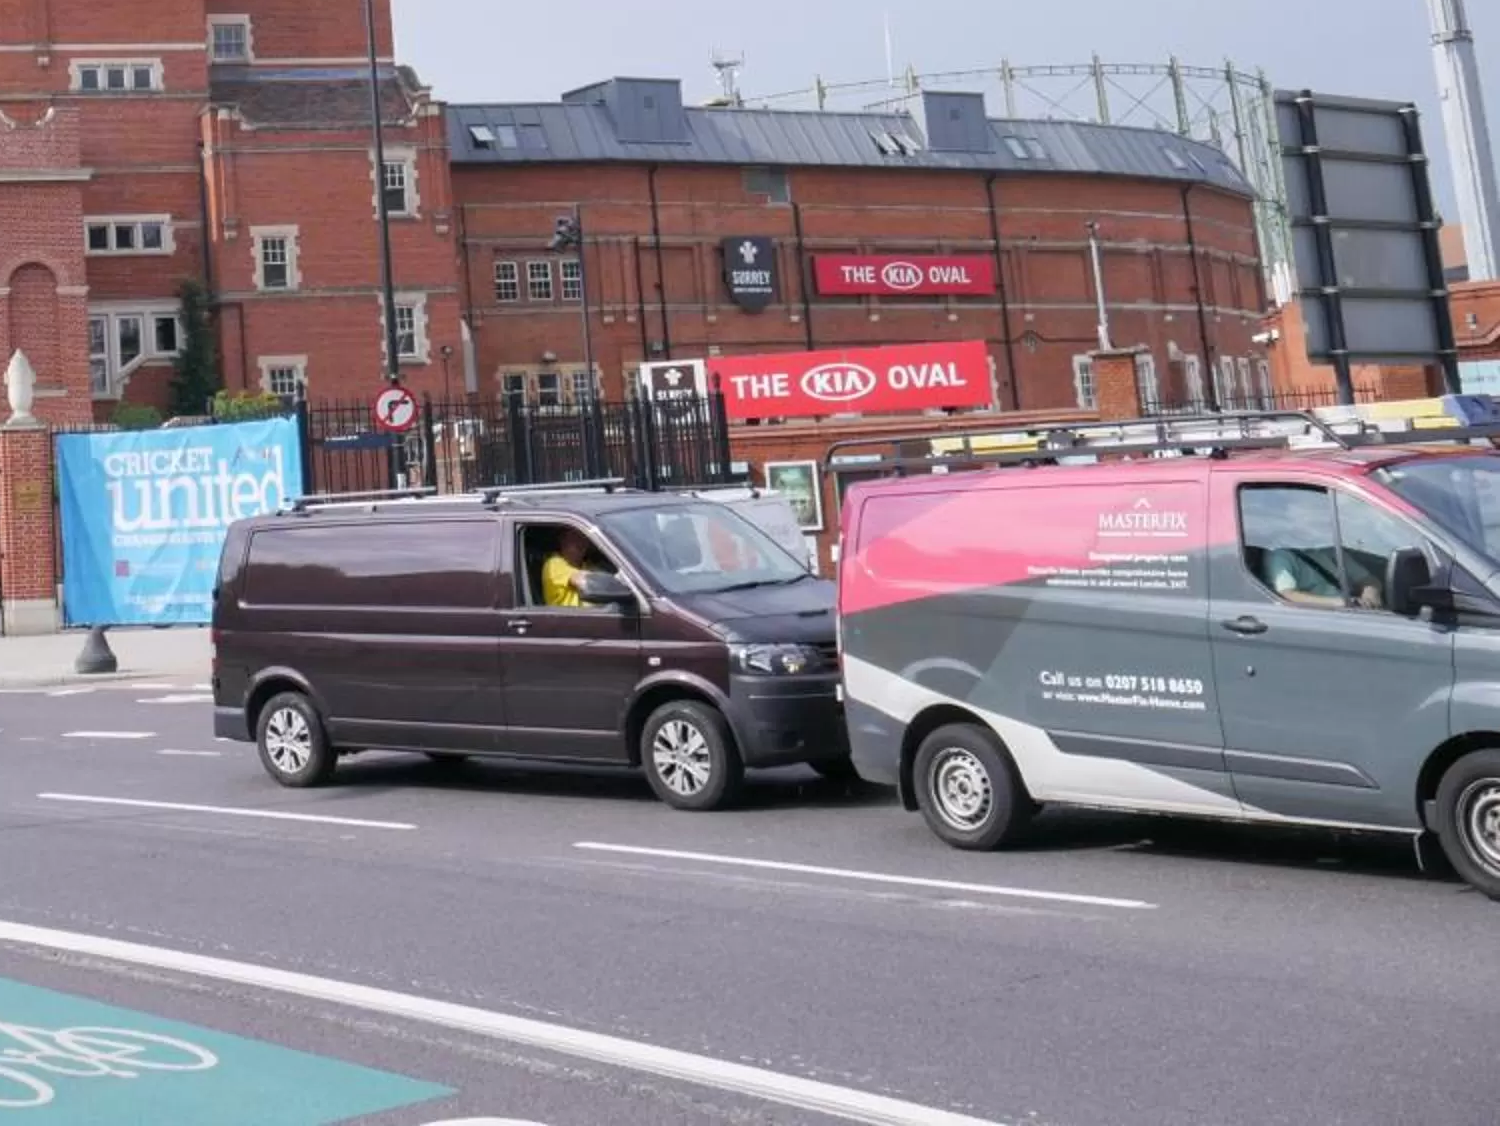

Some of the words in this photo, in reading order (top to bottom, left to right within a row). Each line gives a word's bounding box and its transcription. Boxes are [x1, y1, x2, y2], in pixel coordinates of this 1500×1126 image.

[840, 265, 876, 283] THE
[929, 265, 972, 284] OVAL
[730, 373, 790, 399] THE
[887, 362, 967, 390] OVAL
[103, 445, 213, 476] CRICKET
[105, 444, 295, 532] united
[1098, 511, 1188, 530] MASTERFIX
[1040, 671, 1065, 686] Call
[1067, 676, 1083, 687] us
[1085, 677, 1102, 687] on
[1105, 674, 1137, 690] 0207
